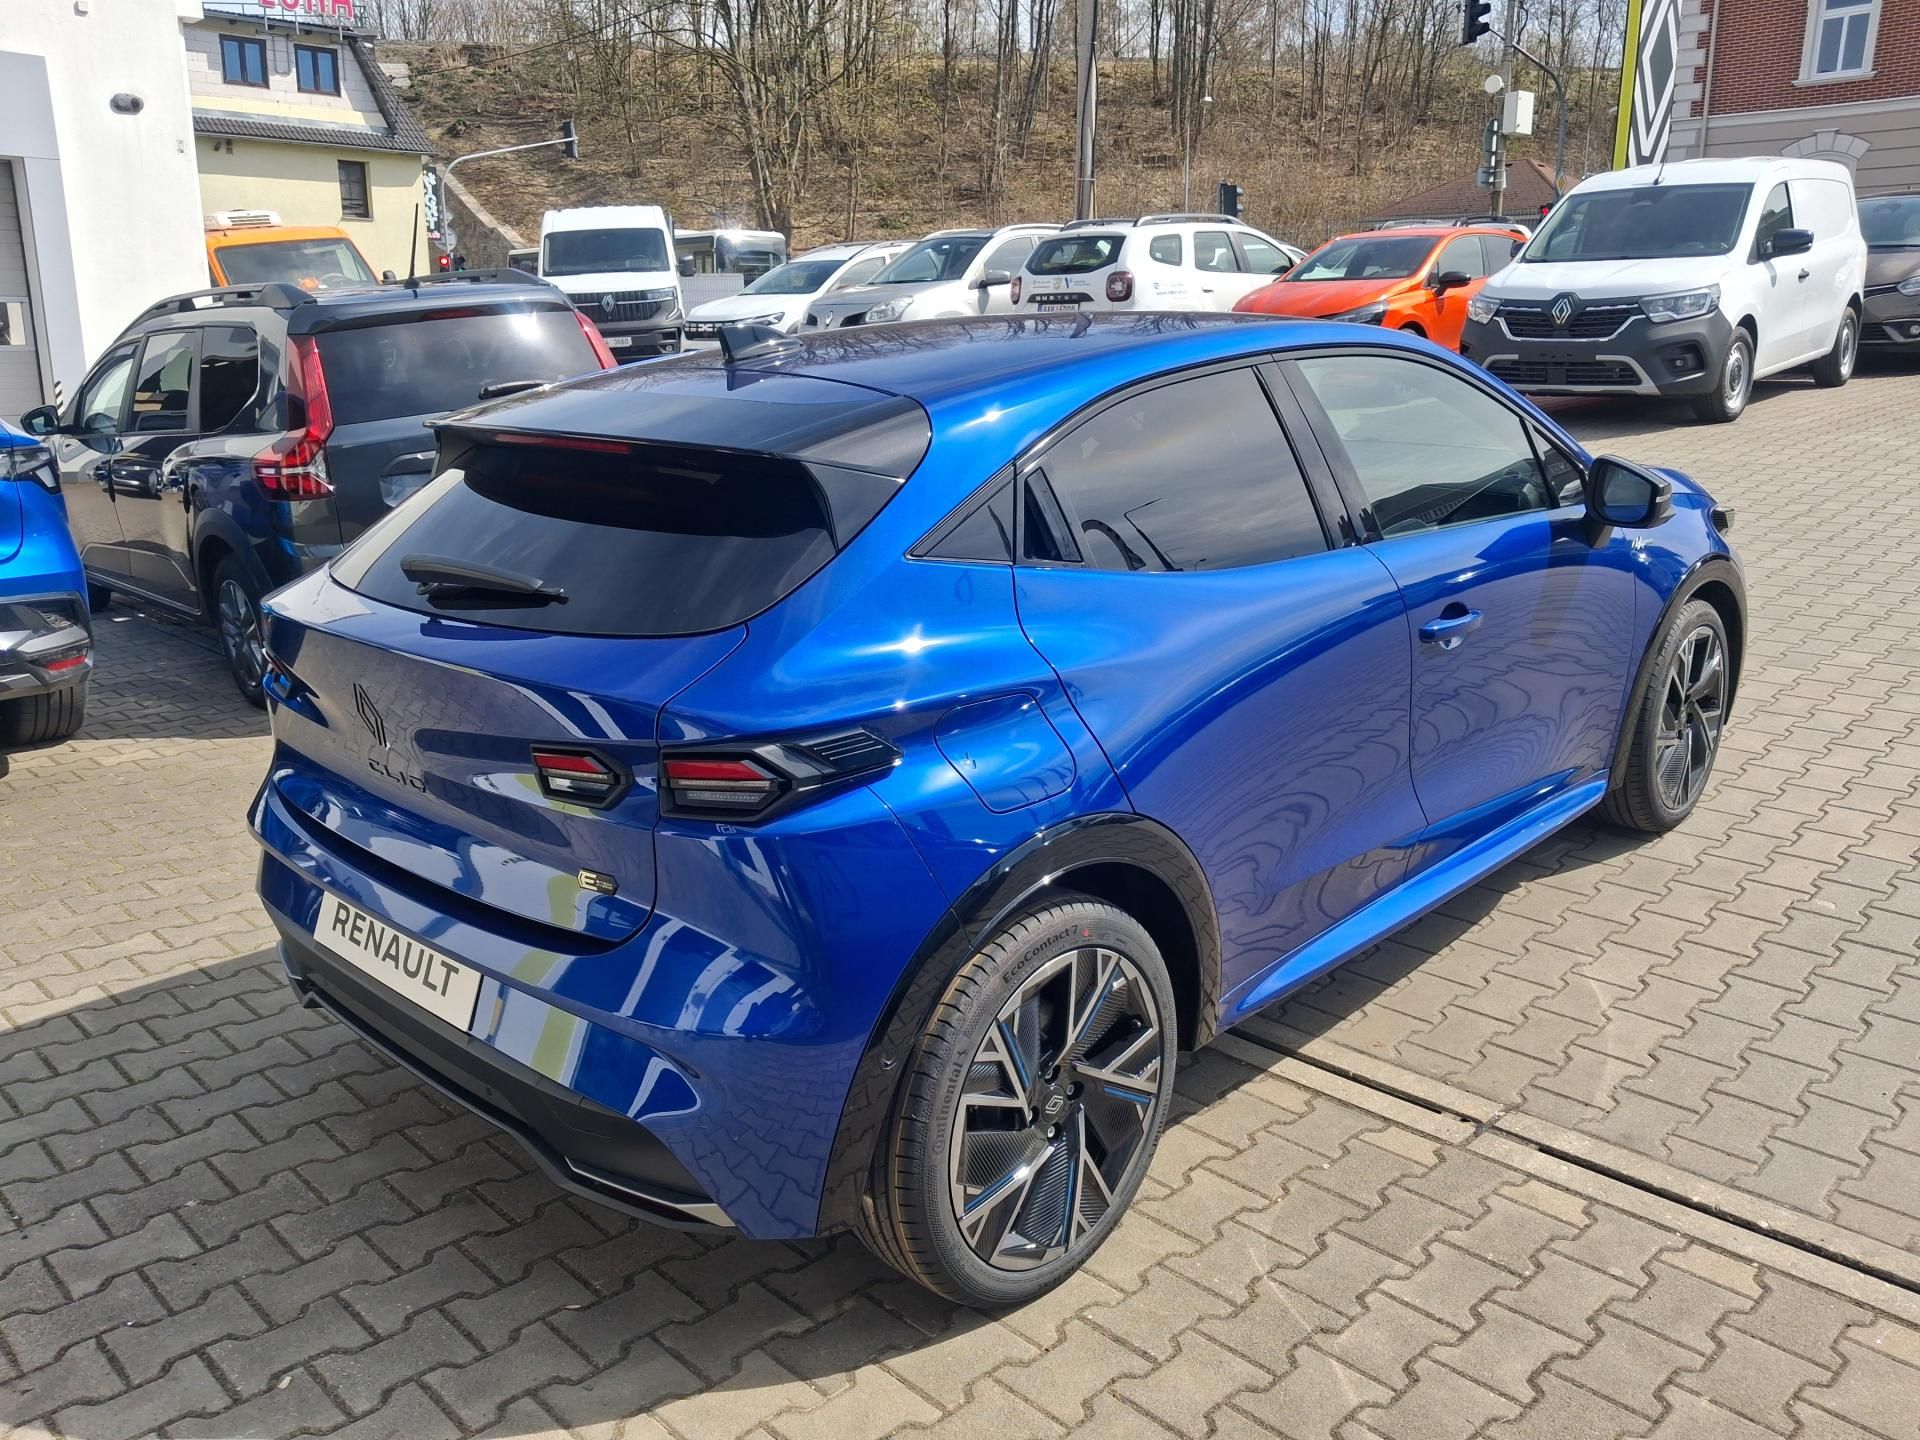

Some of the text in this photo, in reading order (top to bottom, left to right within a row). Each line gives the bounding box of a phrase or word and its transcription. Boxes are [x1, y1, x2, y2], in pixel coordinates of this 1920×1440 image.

[367, 757, 427, 793] CLIO
[331, 900, 460, 998] RENAULT
[1002, 928, 1070, 985] EcoContact
[1071, 924, 1079, 935] 7
[931, 1062, 964, 1154] Continental
